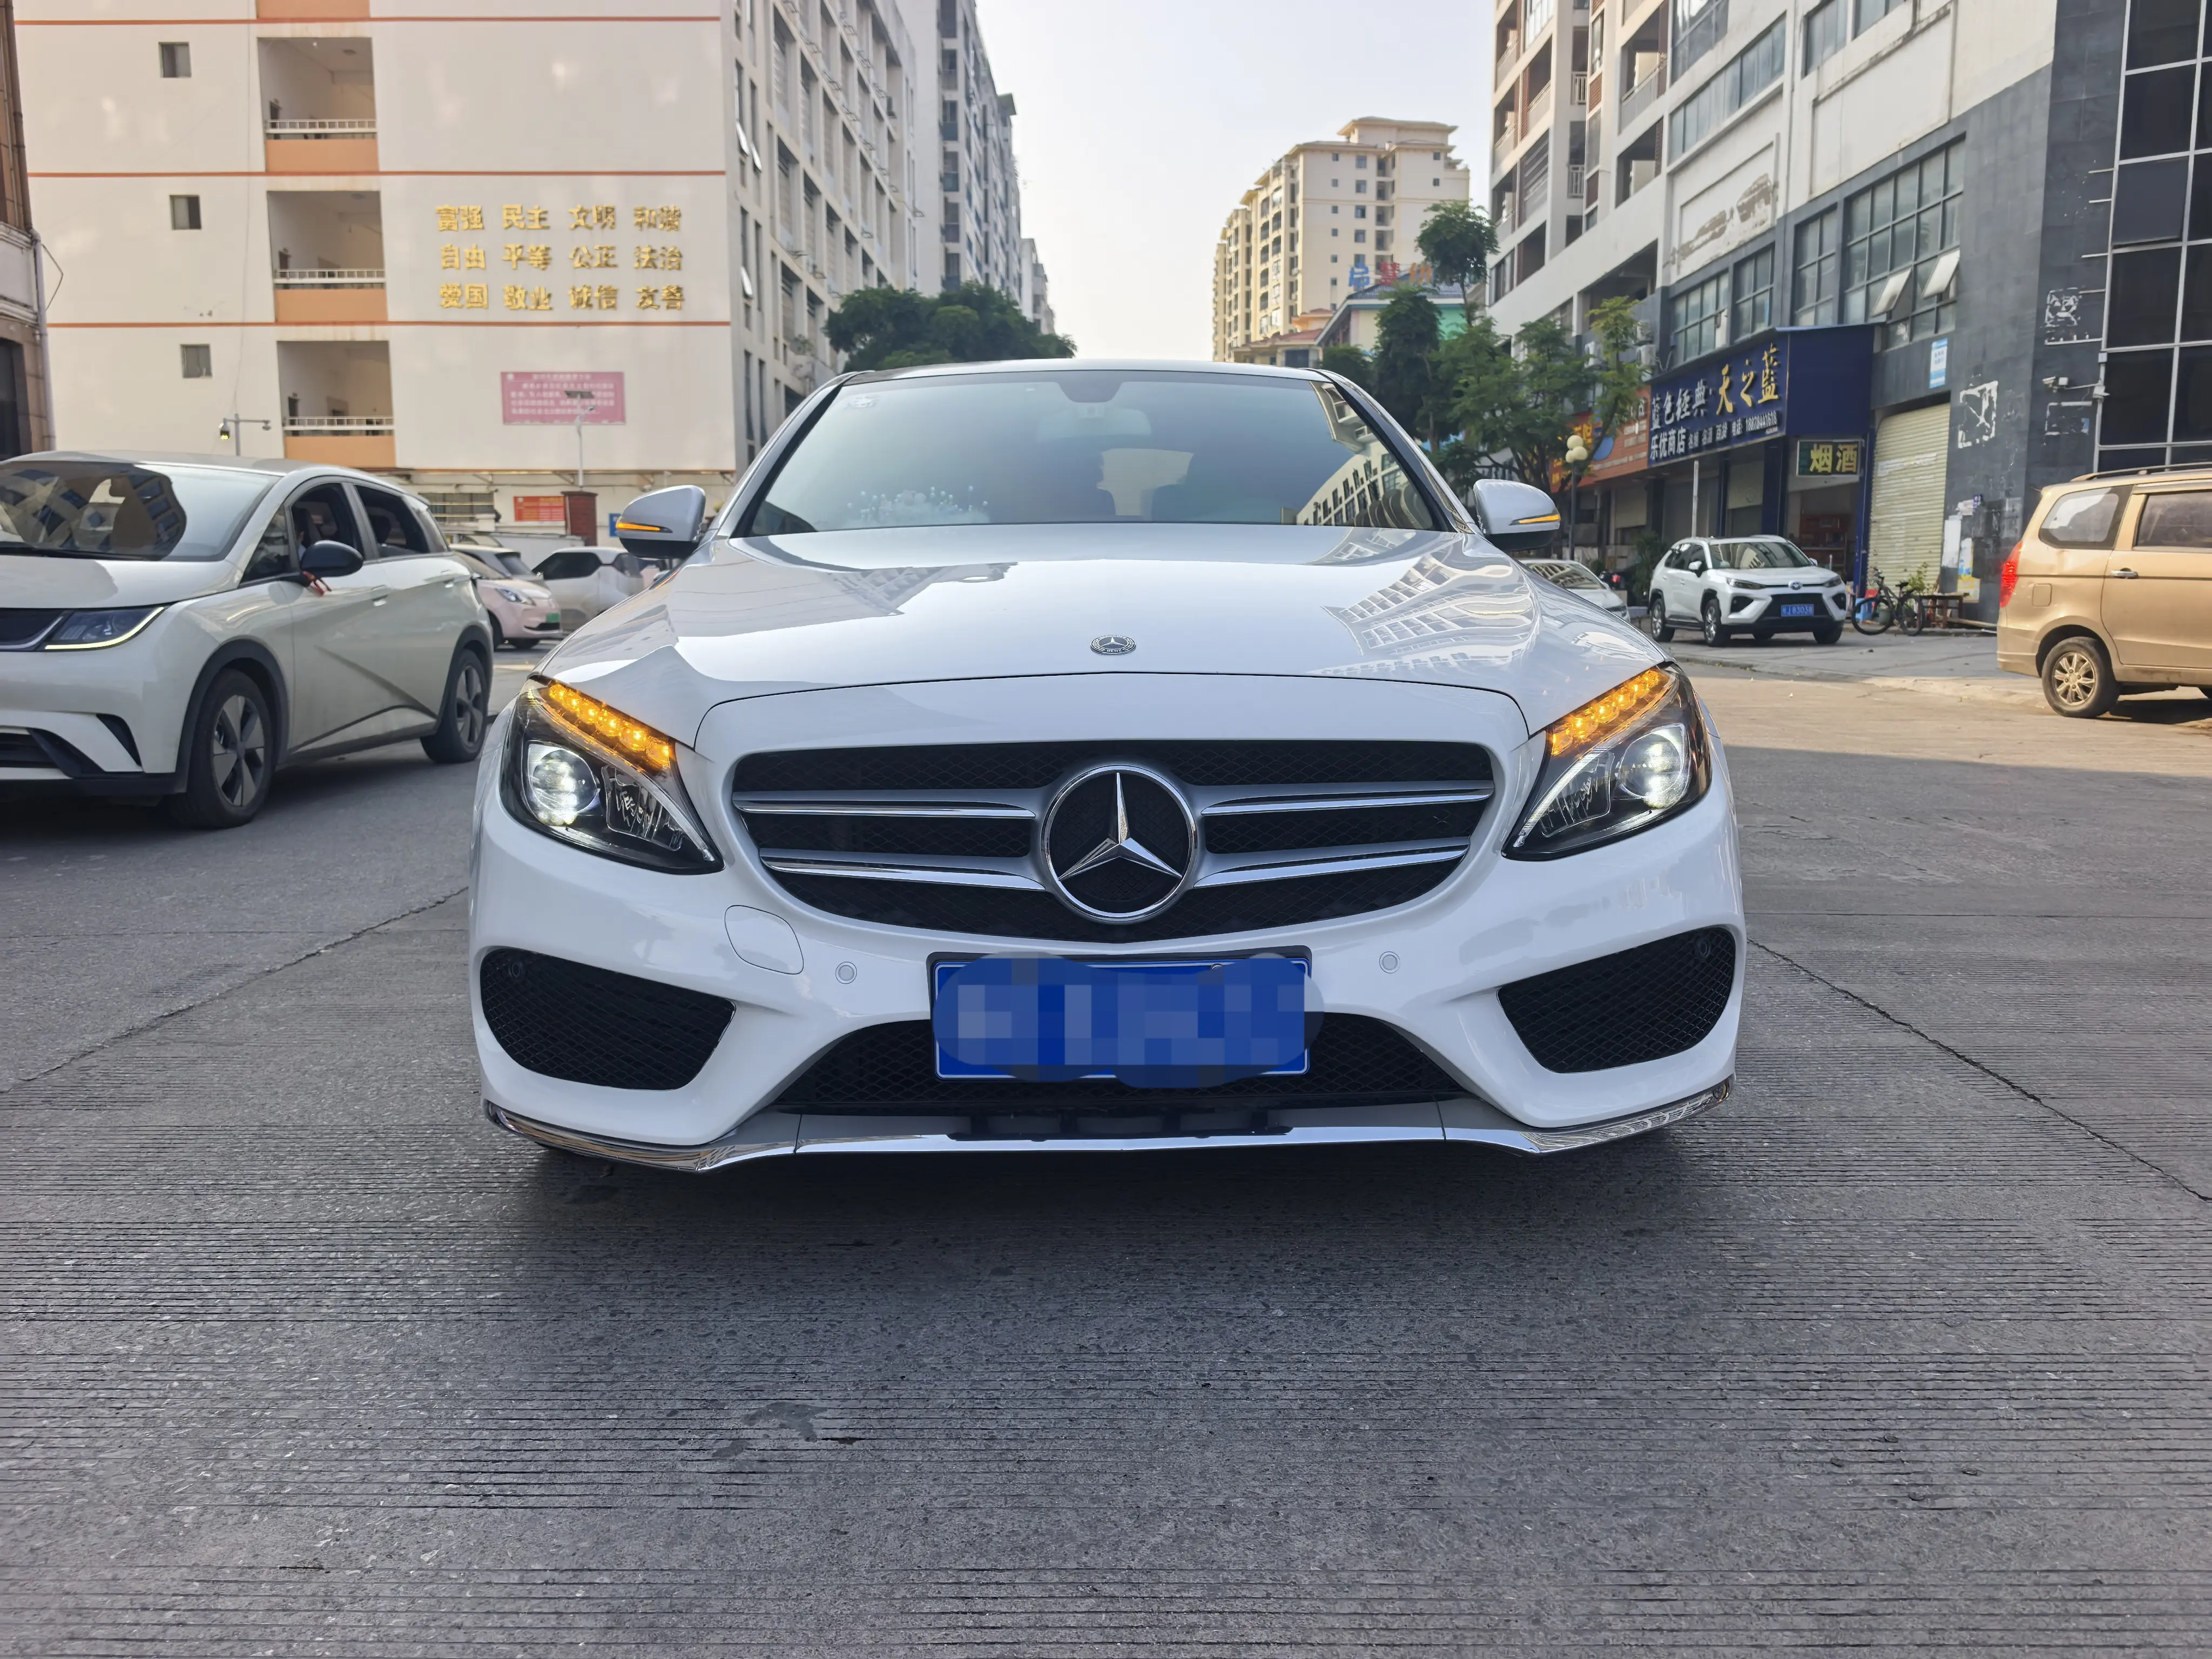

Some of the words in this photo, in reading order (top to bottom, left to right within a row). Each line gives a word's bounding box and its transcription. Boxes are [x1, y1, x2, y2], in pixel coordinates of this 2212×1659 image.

[436, 204, 484, 231] 富强
[502, 204, 550, 230] 民主
[568, 204, 616, 231] 文明
[633, 205, 682, 232] 和谐
[441, 243, 485, 269] 自由
[502, 244, 551, 270] 平等
[569, 245, 618, 269] 公正
[633, 245, 683, 270] 法治
[439, 282, 488, 309] 爱国
[503, 284, 552, 311] 敬业
[568, 284, 619, 311] 诚信
[636, 284, 685, 311] 友善
[1650, 426, 1687, 460] 乐优商店
[1810, 443, 1858, 473] 烟酒
